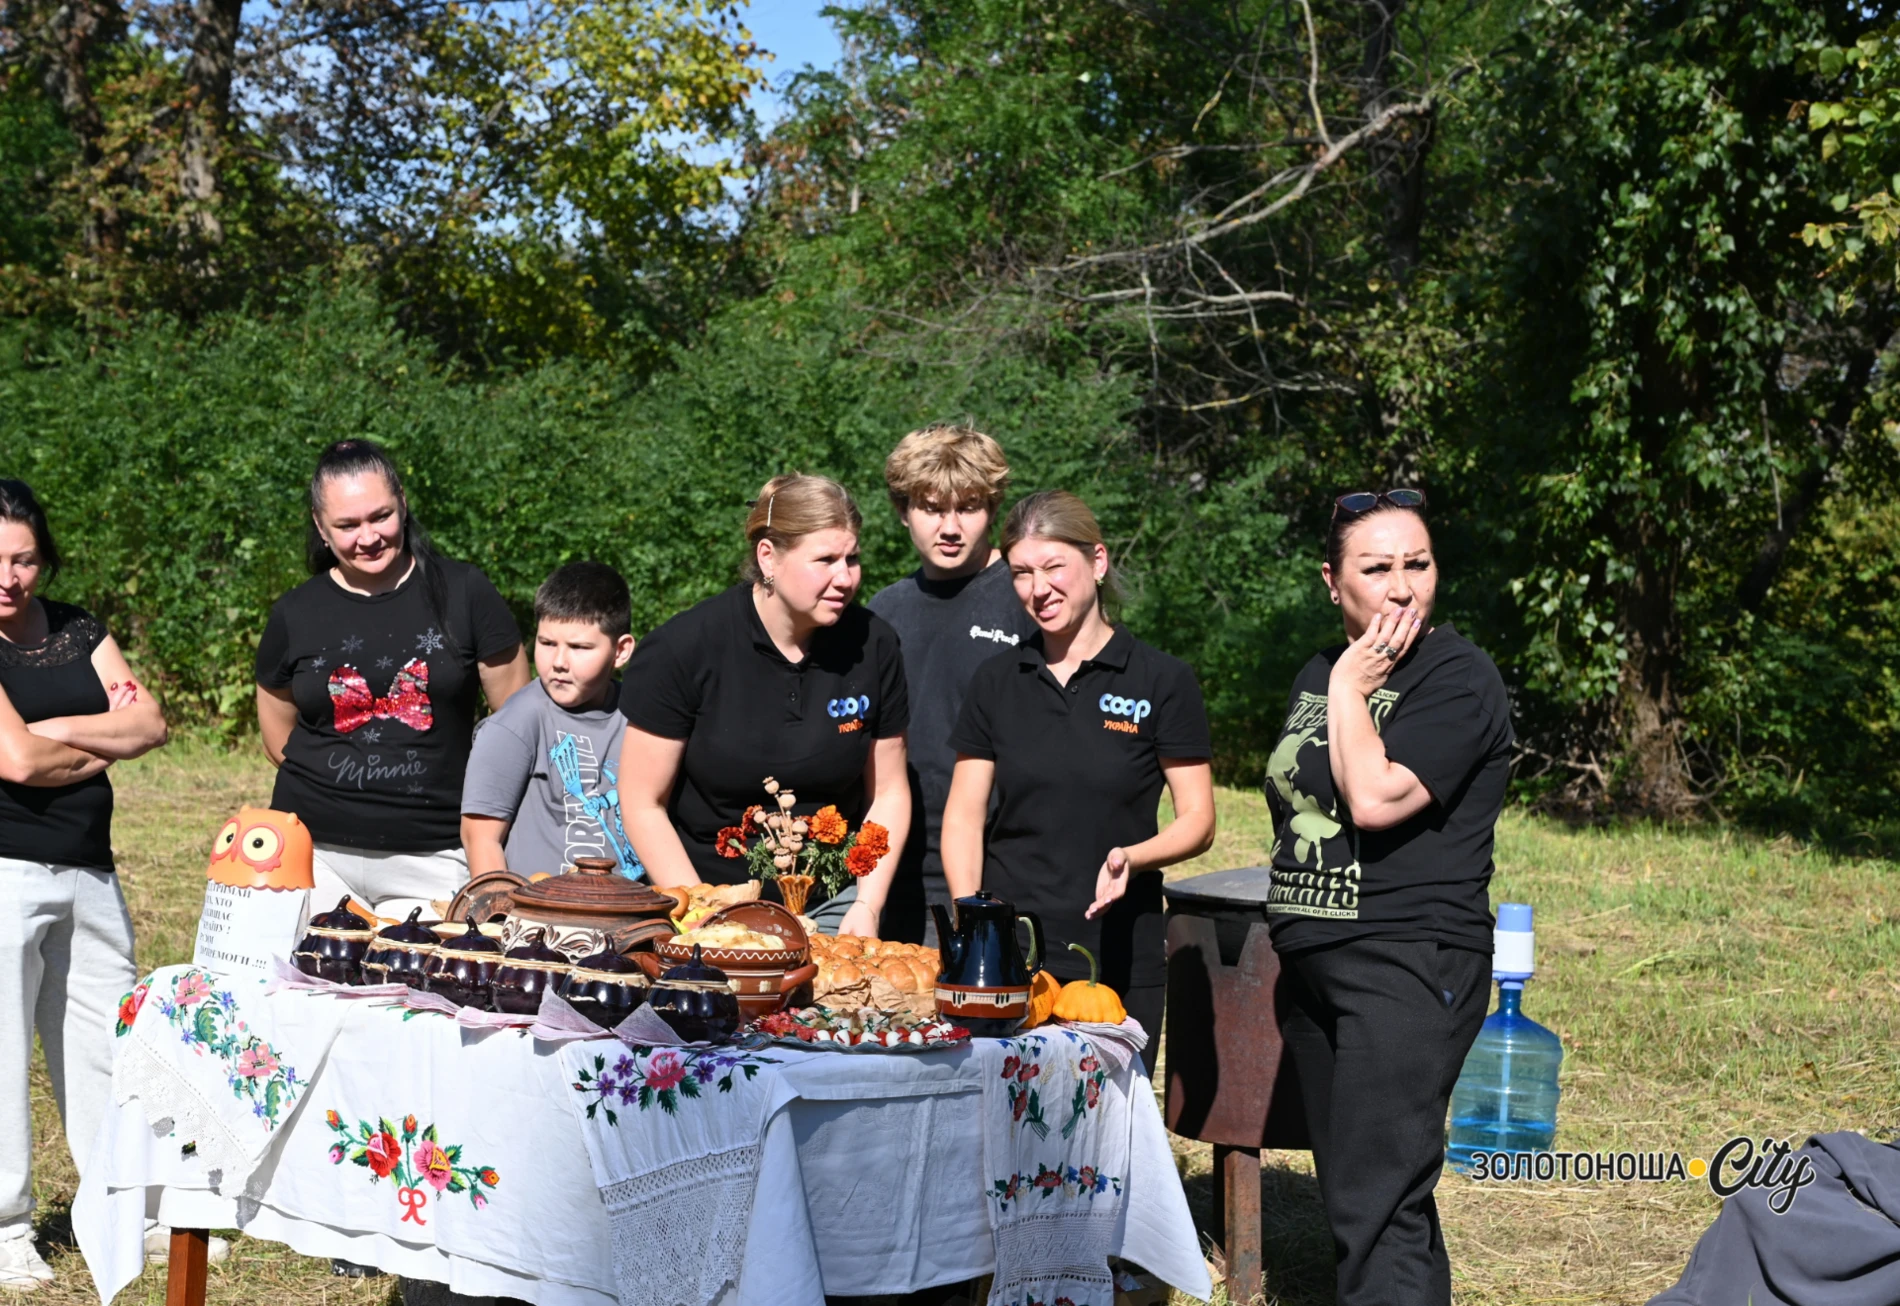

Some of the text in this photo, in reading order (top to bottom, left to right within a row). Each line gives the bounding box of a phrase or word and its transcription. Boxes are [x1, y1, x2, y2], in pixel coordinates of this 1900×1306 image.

[827, 694, 870, 719] coop
[1099, 692, 1152, 723] coop
[1103, 719, 1139, 734] УКРАЇНА
[328, 750, 427, 790] Minnie
